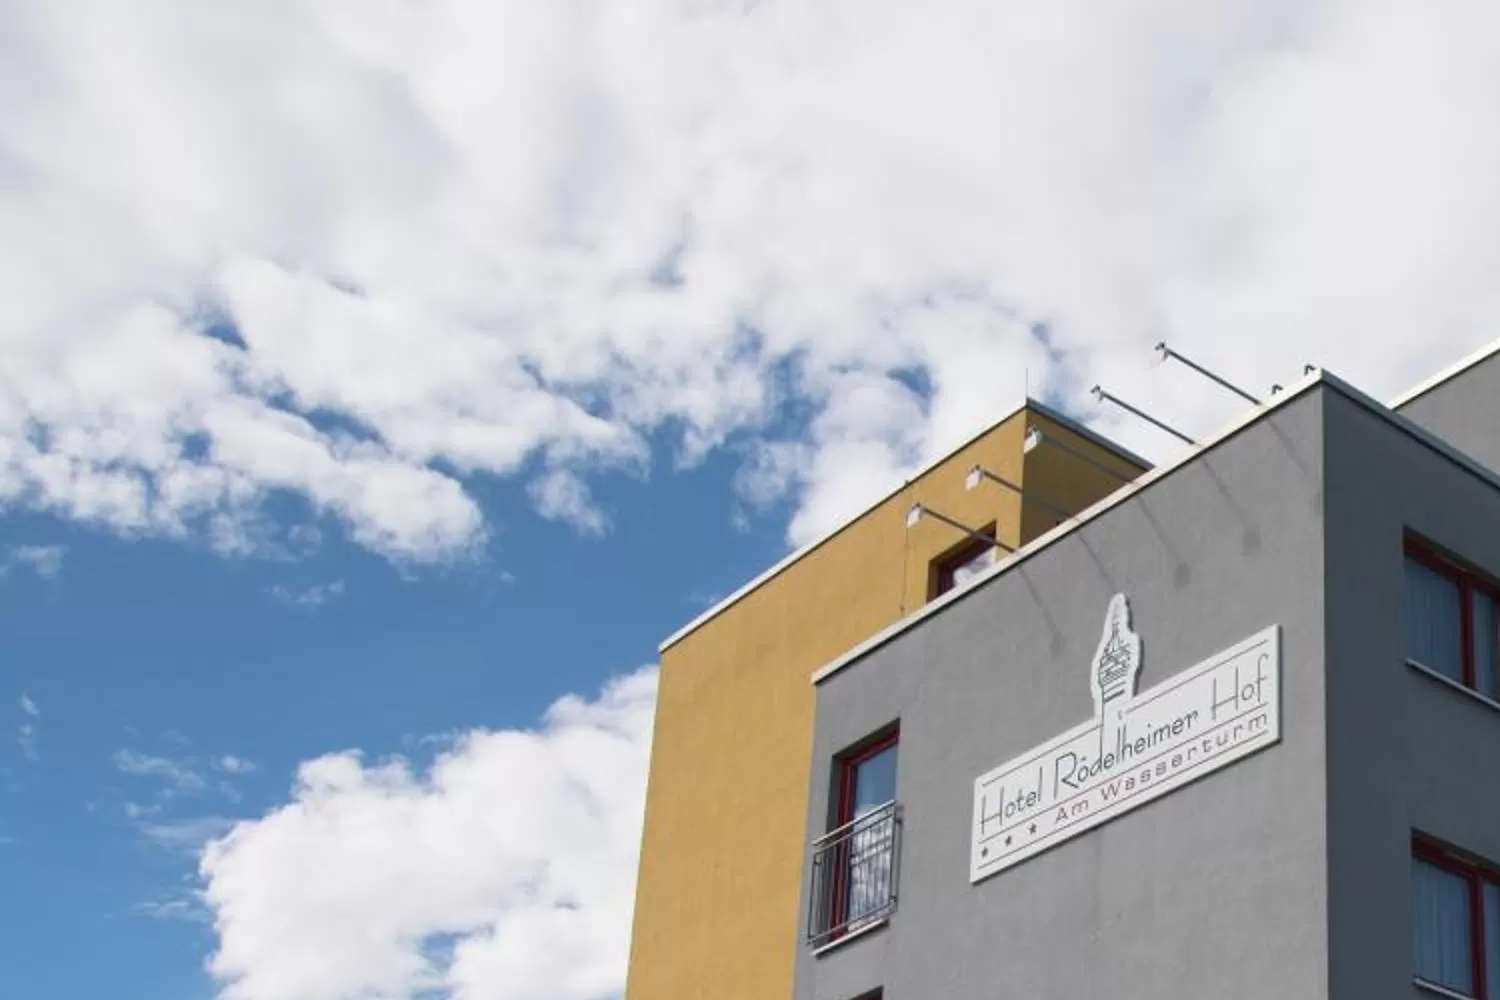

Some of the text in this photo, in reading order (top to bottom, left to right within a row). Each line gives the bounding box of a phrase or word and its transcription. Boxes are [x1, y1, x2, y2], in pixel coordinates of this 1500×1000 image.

[980, 652, 1269, 834] Hotel Rödelheimer Hof
[1055, 711, 1269, 824] Am Wasserturm
